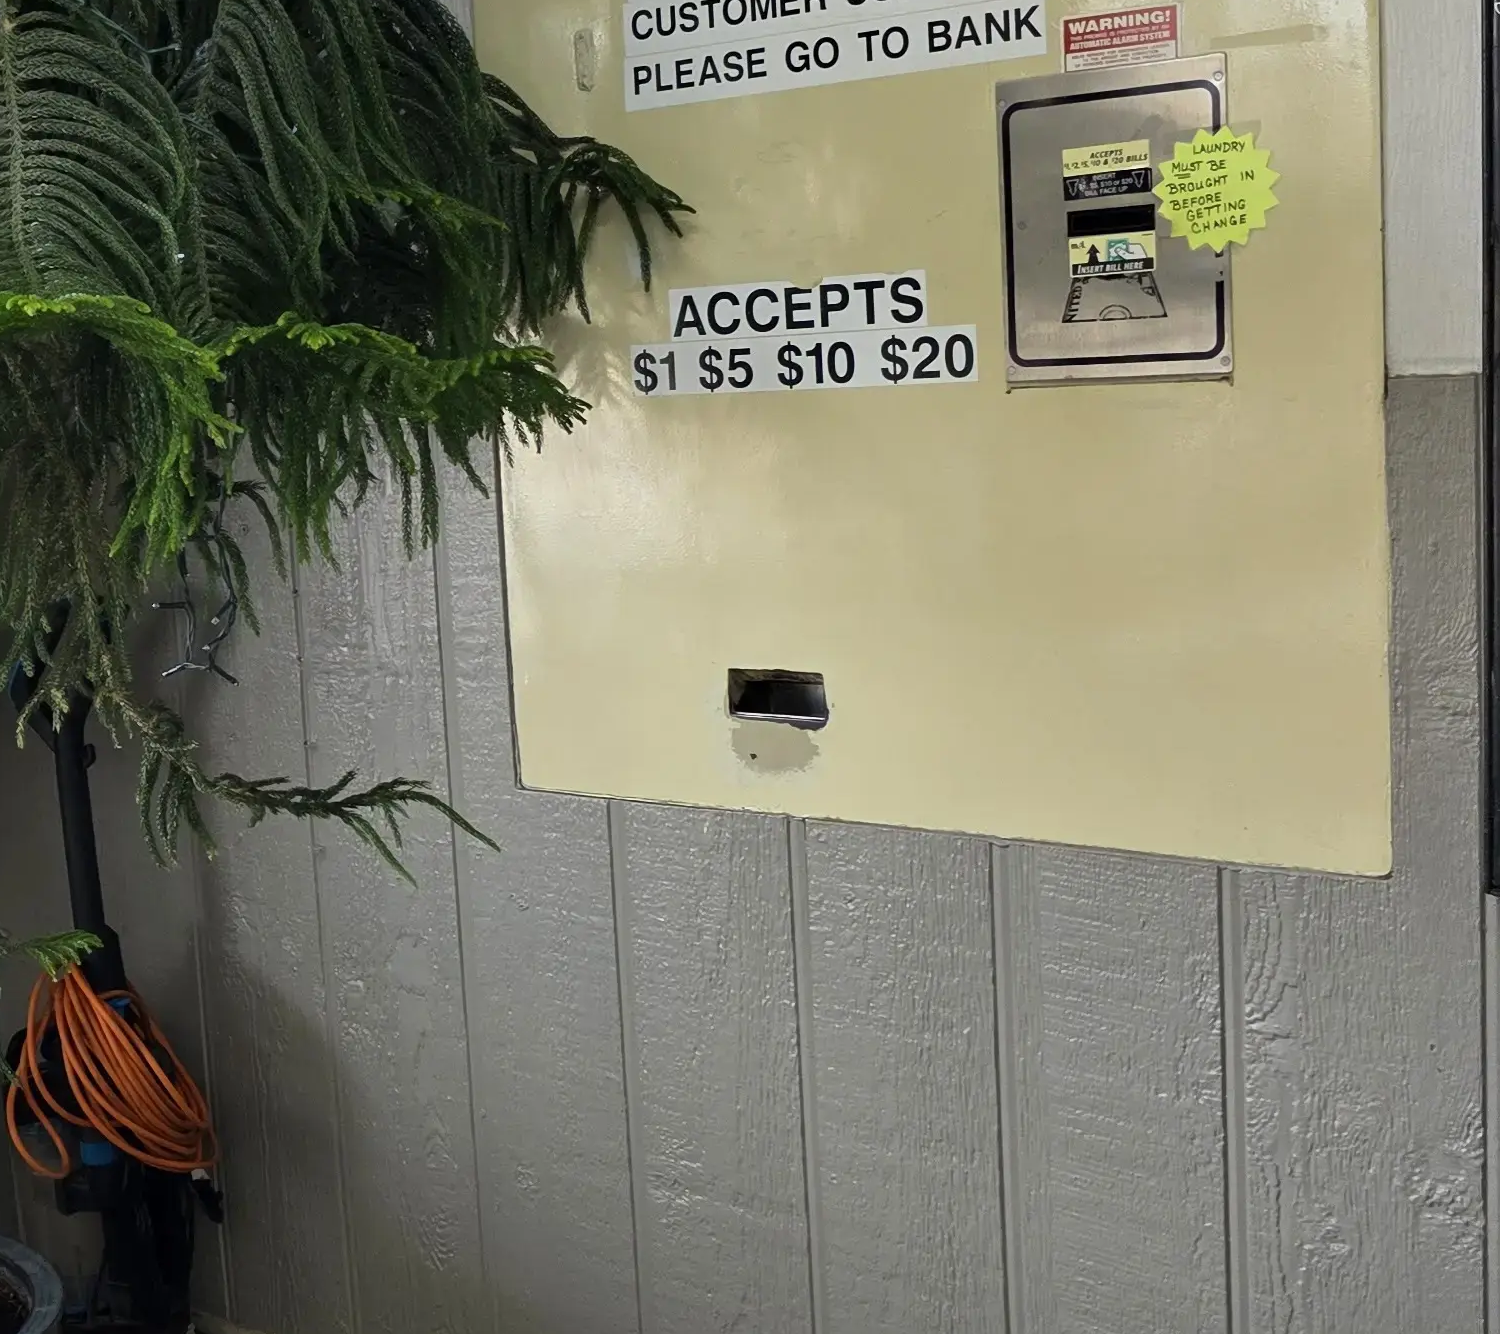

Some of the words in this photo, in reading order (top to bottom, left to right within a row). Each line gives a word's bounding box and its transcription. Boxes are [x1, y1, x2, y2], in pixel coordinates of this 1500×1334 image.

[1068, 10, 1171, 35] WARNING!
[633, 47, 767, 96] PLEASE
[784, 36, 840, 74] GO
[858, 25, 909, 62] TO
[927, 4, 1042, 54] BANK
[1090, 149, 1123, 159] ACCEPTS
[1125, 153, 1149, 163] BILLS
[1193, 141, 1245, 155] LAUNDRY
[1171, 161, 1203, 173] MUST
[1206, 159, 1227, 171] BE
[1165, 175, 1228, 195] BROUGHT
[1240, 169, 1254, 181] IN
[1170, 192, 1222, 211] BEFORE
[1186, 199, 1246, 222] GETTING
[1191, 214, 1247, 234] CHANGE
[1105, 263, 1122, 272] BILL
[673, 276, 923, 338] ACCEPTS
[633, 348, 677, 395] $1
[699, 345, 753, 393] $5
[777, 340, 855, 389] $10
[880, 333, 974, 384] $20
